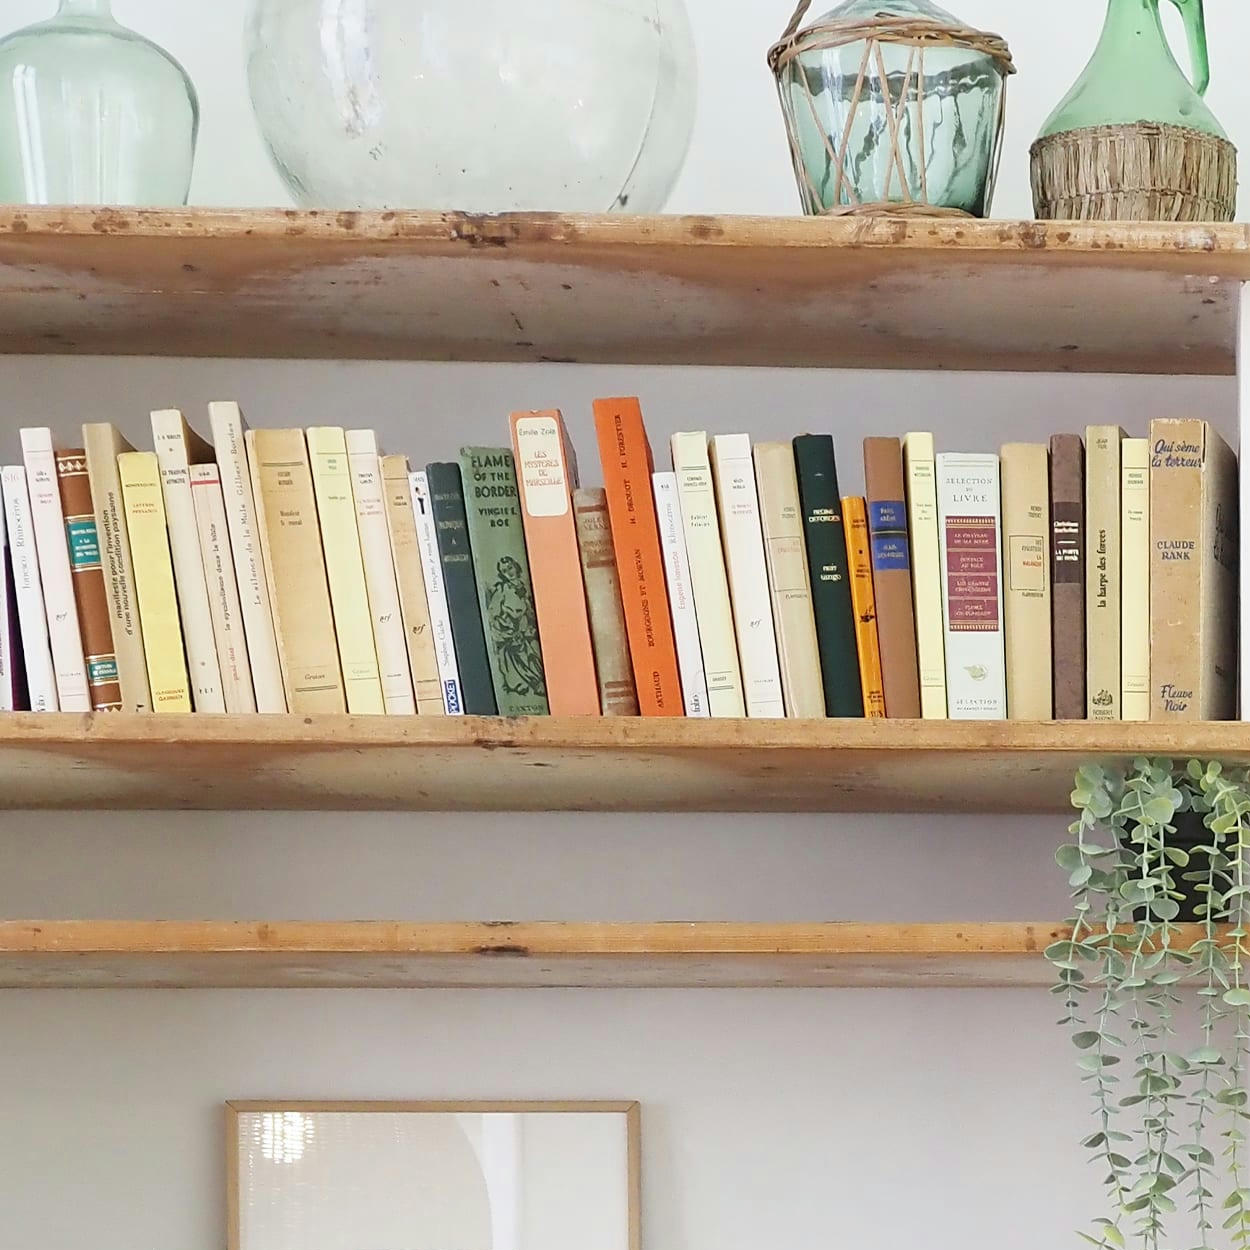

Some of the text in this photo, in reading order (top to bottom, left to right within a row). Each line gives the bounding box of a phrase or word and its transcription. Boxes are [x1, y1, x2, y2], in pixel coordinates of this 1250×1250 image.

[1154, 439, 1200, 454] Qui sème
[471, 454, 511, 468] FLAME
[1151, 455, 1202, 468] la terreur
[473, 472, 510, 482] OF THE
[475, 486, 517, 498] BORDER
[953, 494, 988, 503] LIVRE
[1157, 541, 1195, 550] CLAUDE
[114, 533, 125, 574] condition
[1161, 551, 1190, 560] RANK
[109, 554, 118, 576] pour
[1096, 556, 1107, 571] des
[119, 575, 130, 610] nouvelle
[1096, 573, 1109, 597] harpe
[112, 577, 123, 619] manifeste
[1096, 600, 1107, 608] la
[124, 612, 133, 636] d'une
[446, 680, 459, 714] POCKET
[653, 671, 664, 709] ARTHAUD
[1160, 684, 1193, 699] Fleuve
[1165, 699, 1188, 711] Noir
